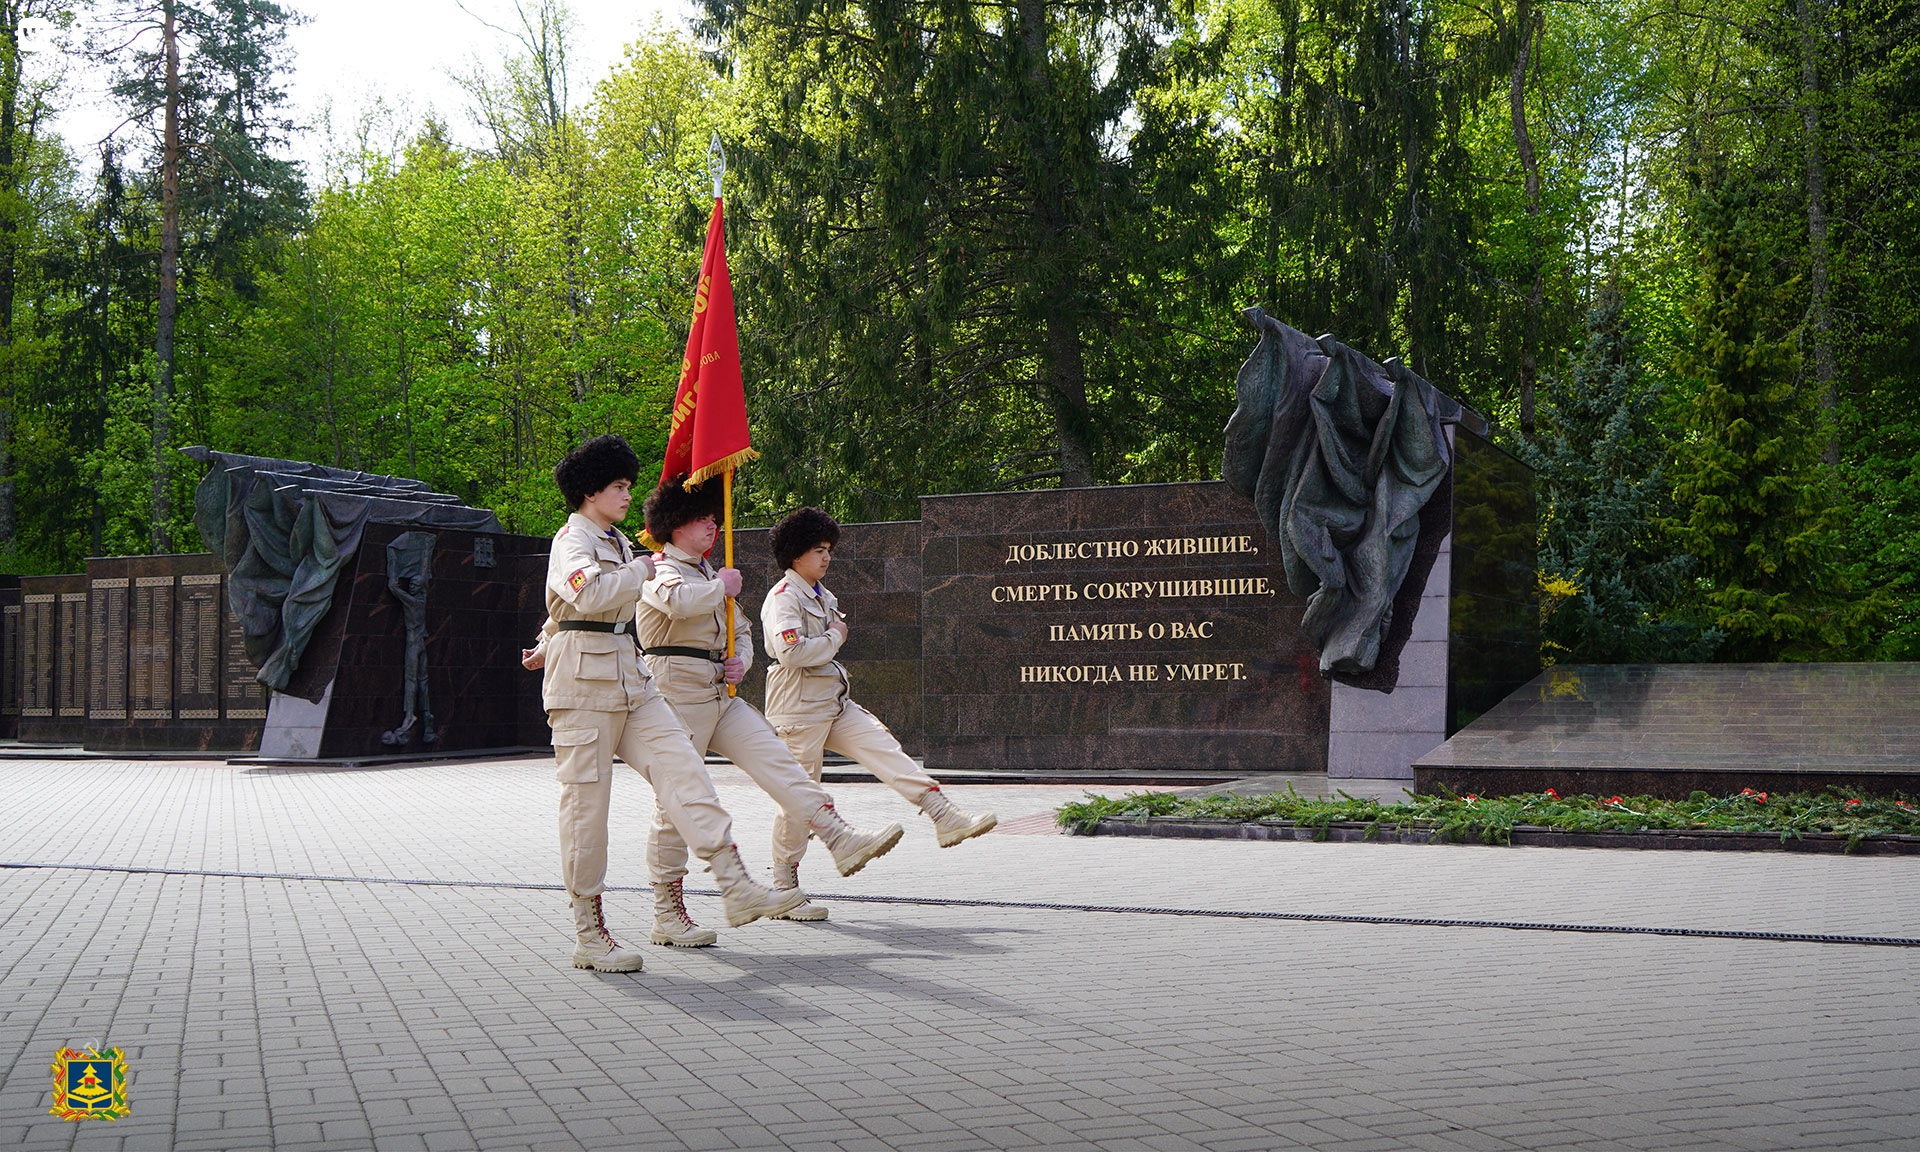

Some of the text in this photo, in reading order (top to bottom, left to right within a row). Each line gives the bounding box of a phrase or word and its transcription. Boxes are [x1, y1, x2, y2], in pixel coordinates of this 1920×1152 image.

[1006, 536, 1258, 564] ДОБЛЕСТНО ЖИВШИЕ,
[992, 578, 1275, 602] СМЕРТЬ СОКРУШИВШИЕ,
[1050, 622, 1213, 641] ПАМЯТЬ О ВАС
[1020, 664, 1246, 685] НИКОГДА НЕ УМРЕТ.
